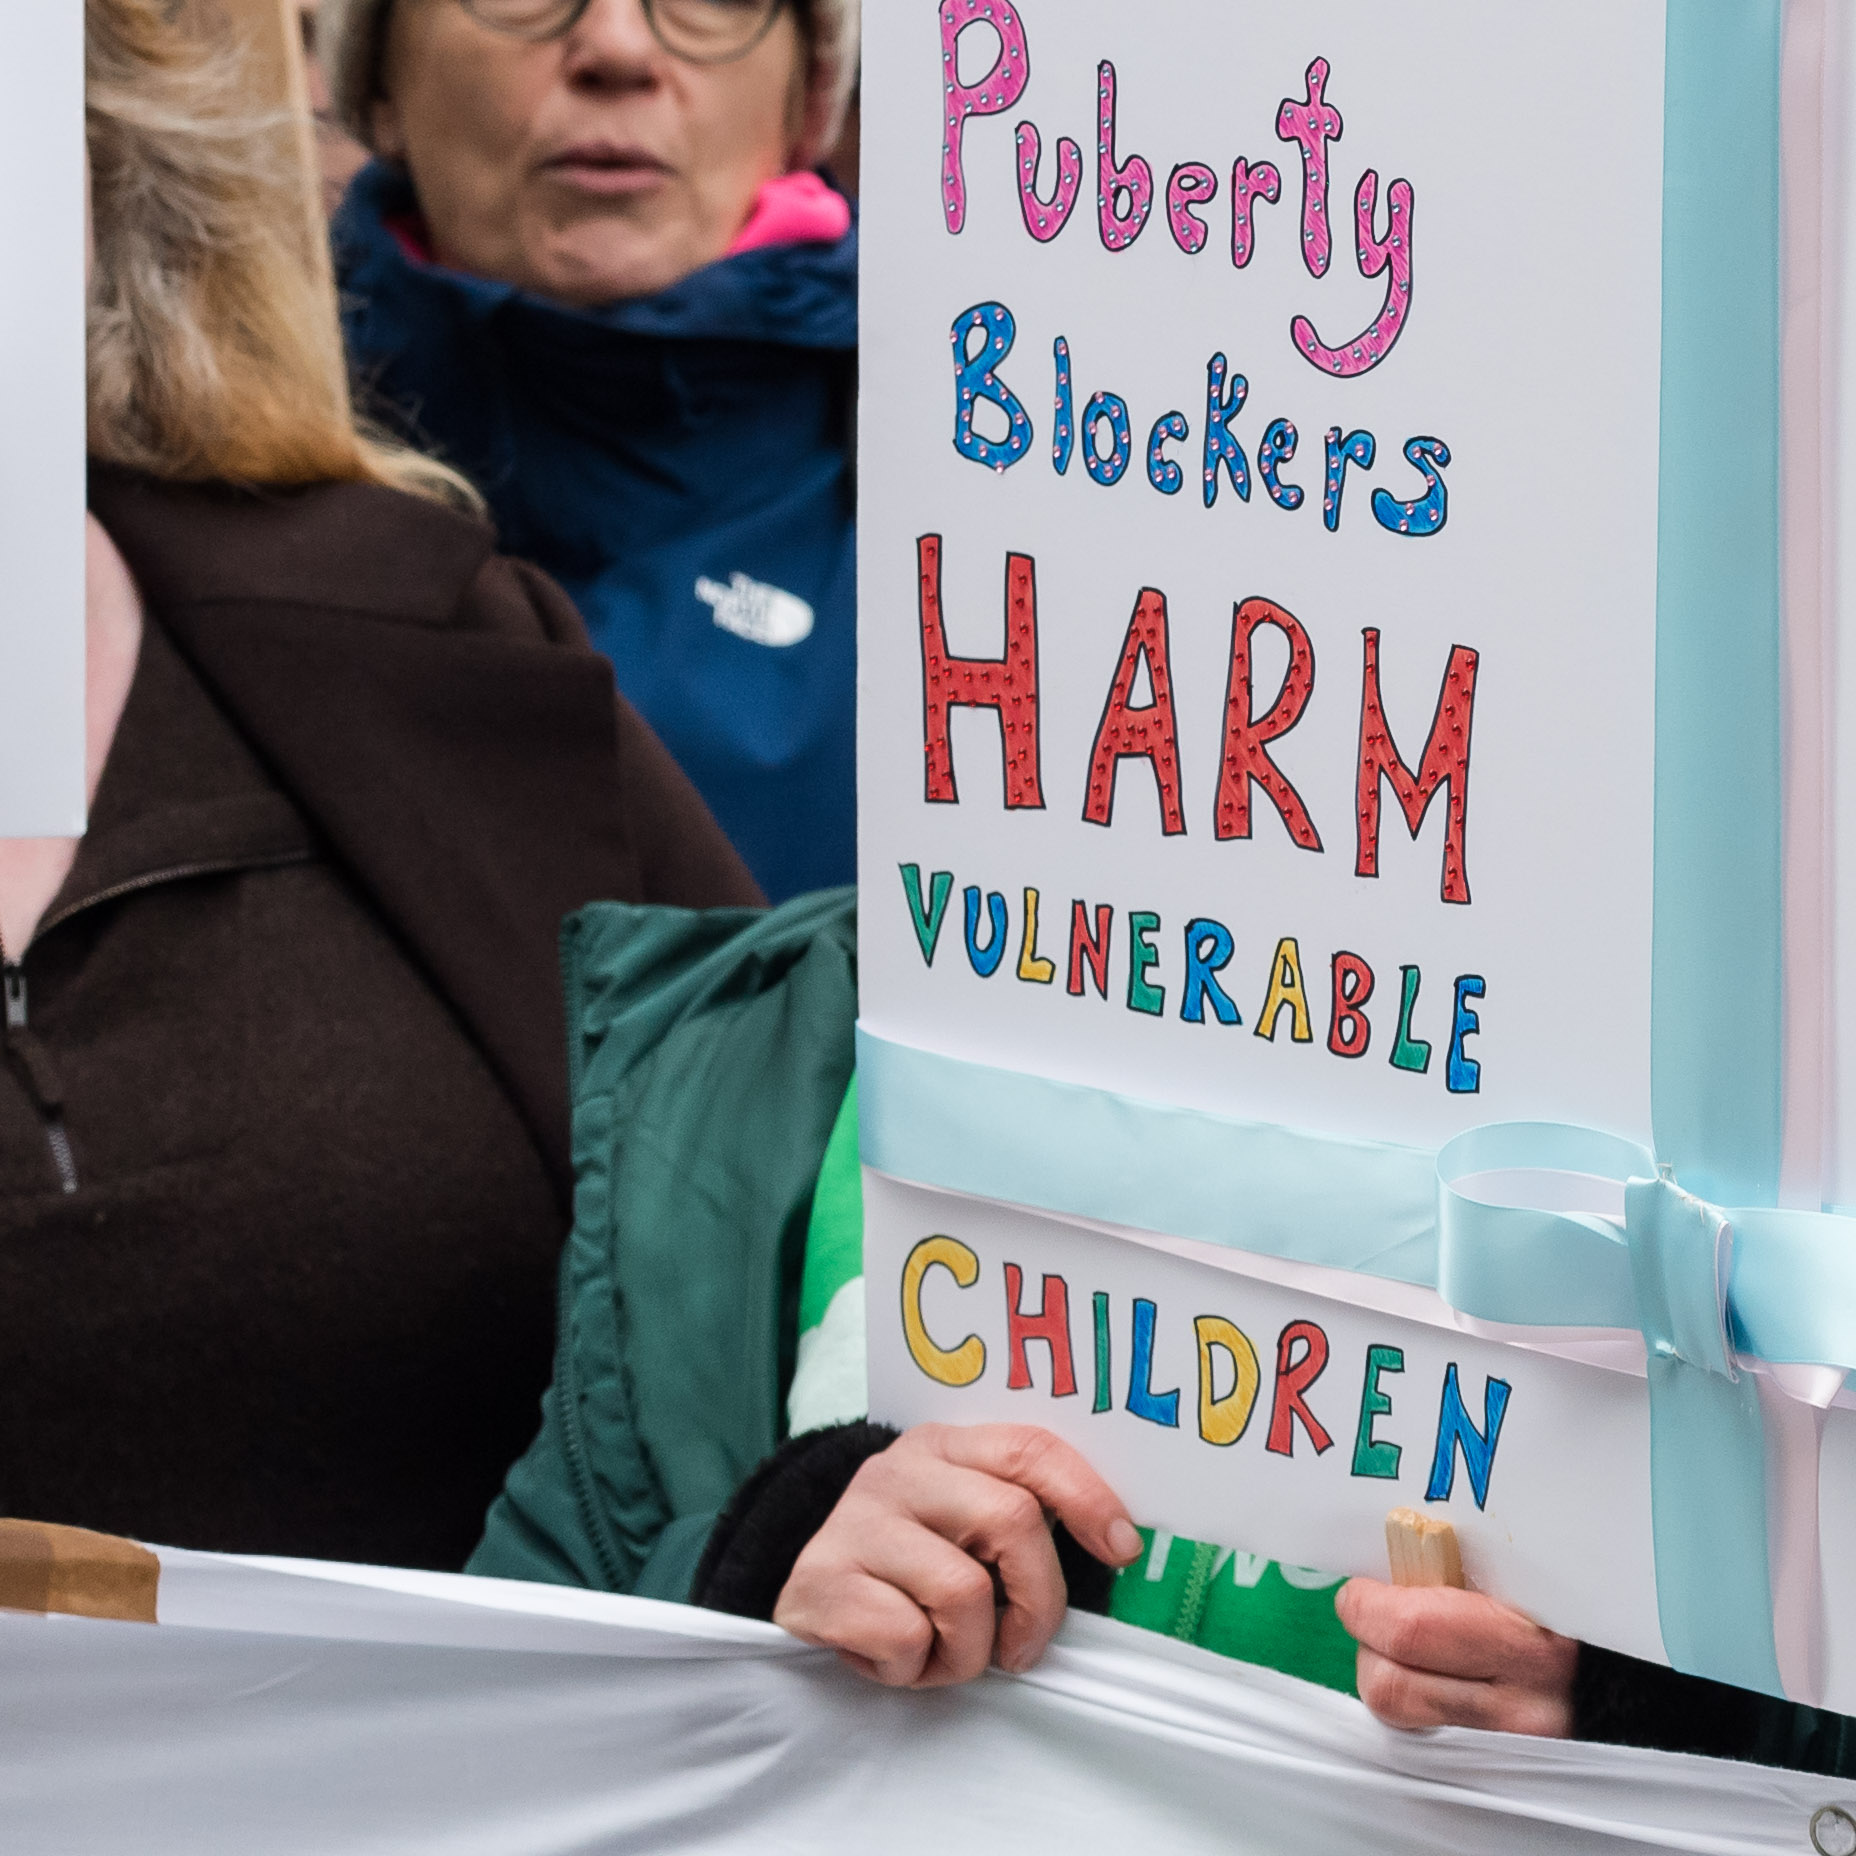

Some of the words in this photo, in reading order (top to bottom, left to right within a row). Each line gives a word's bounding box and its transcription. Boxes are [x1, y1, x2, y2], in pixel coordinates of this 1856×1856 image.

[950, 301, 1450, 537] Blockers
[916, 533, 1481, 906] HARM
[897, 861, 1487, 1094] VULNERABLE
[898, 1234, 1513, 1509] CHILDREN
